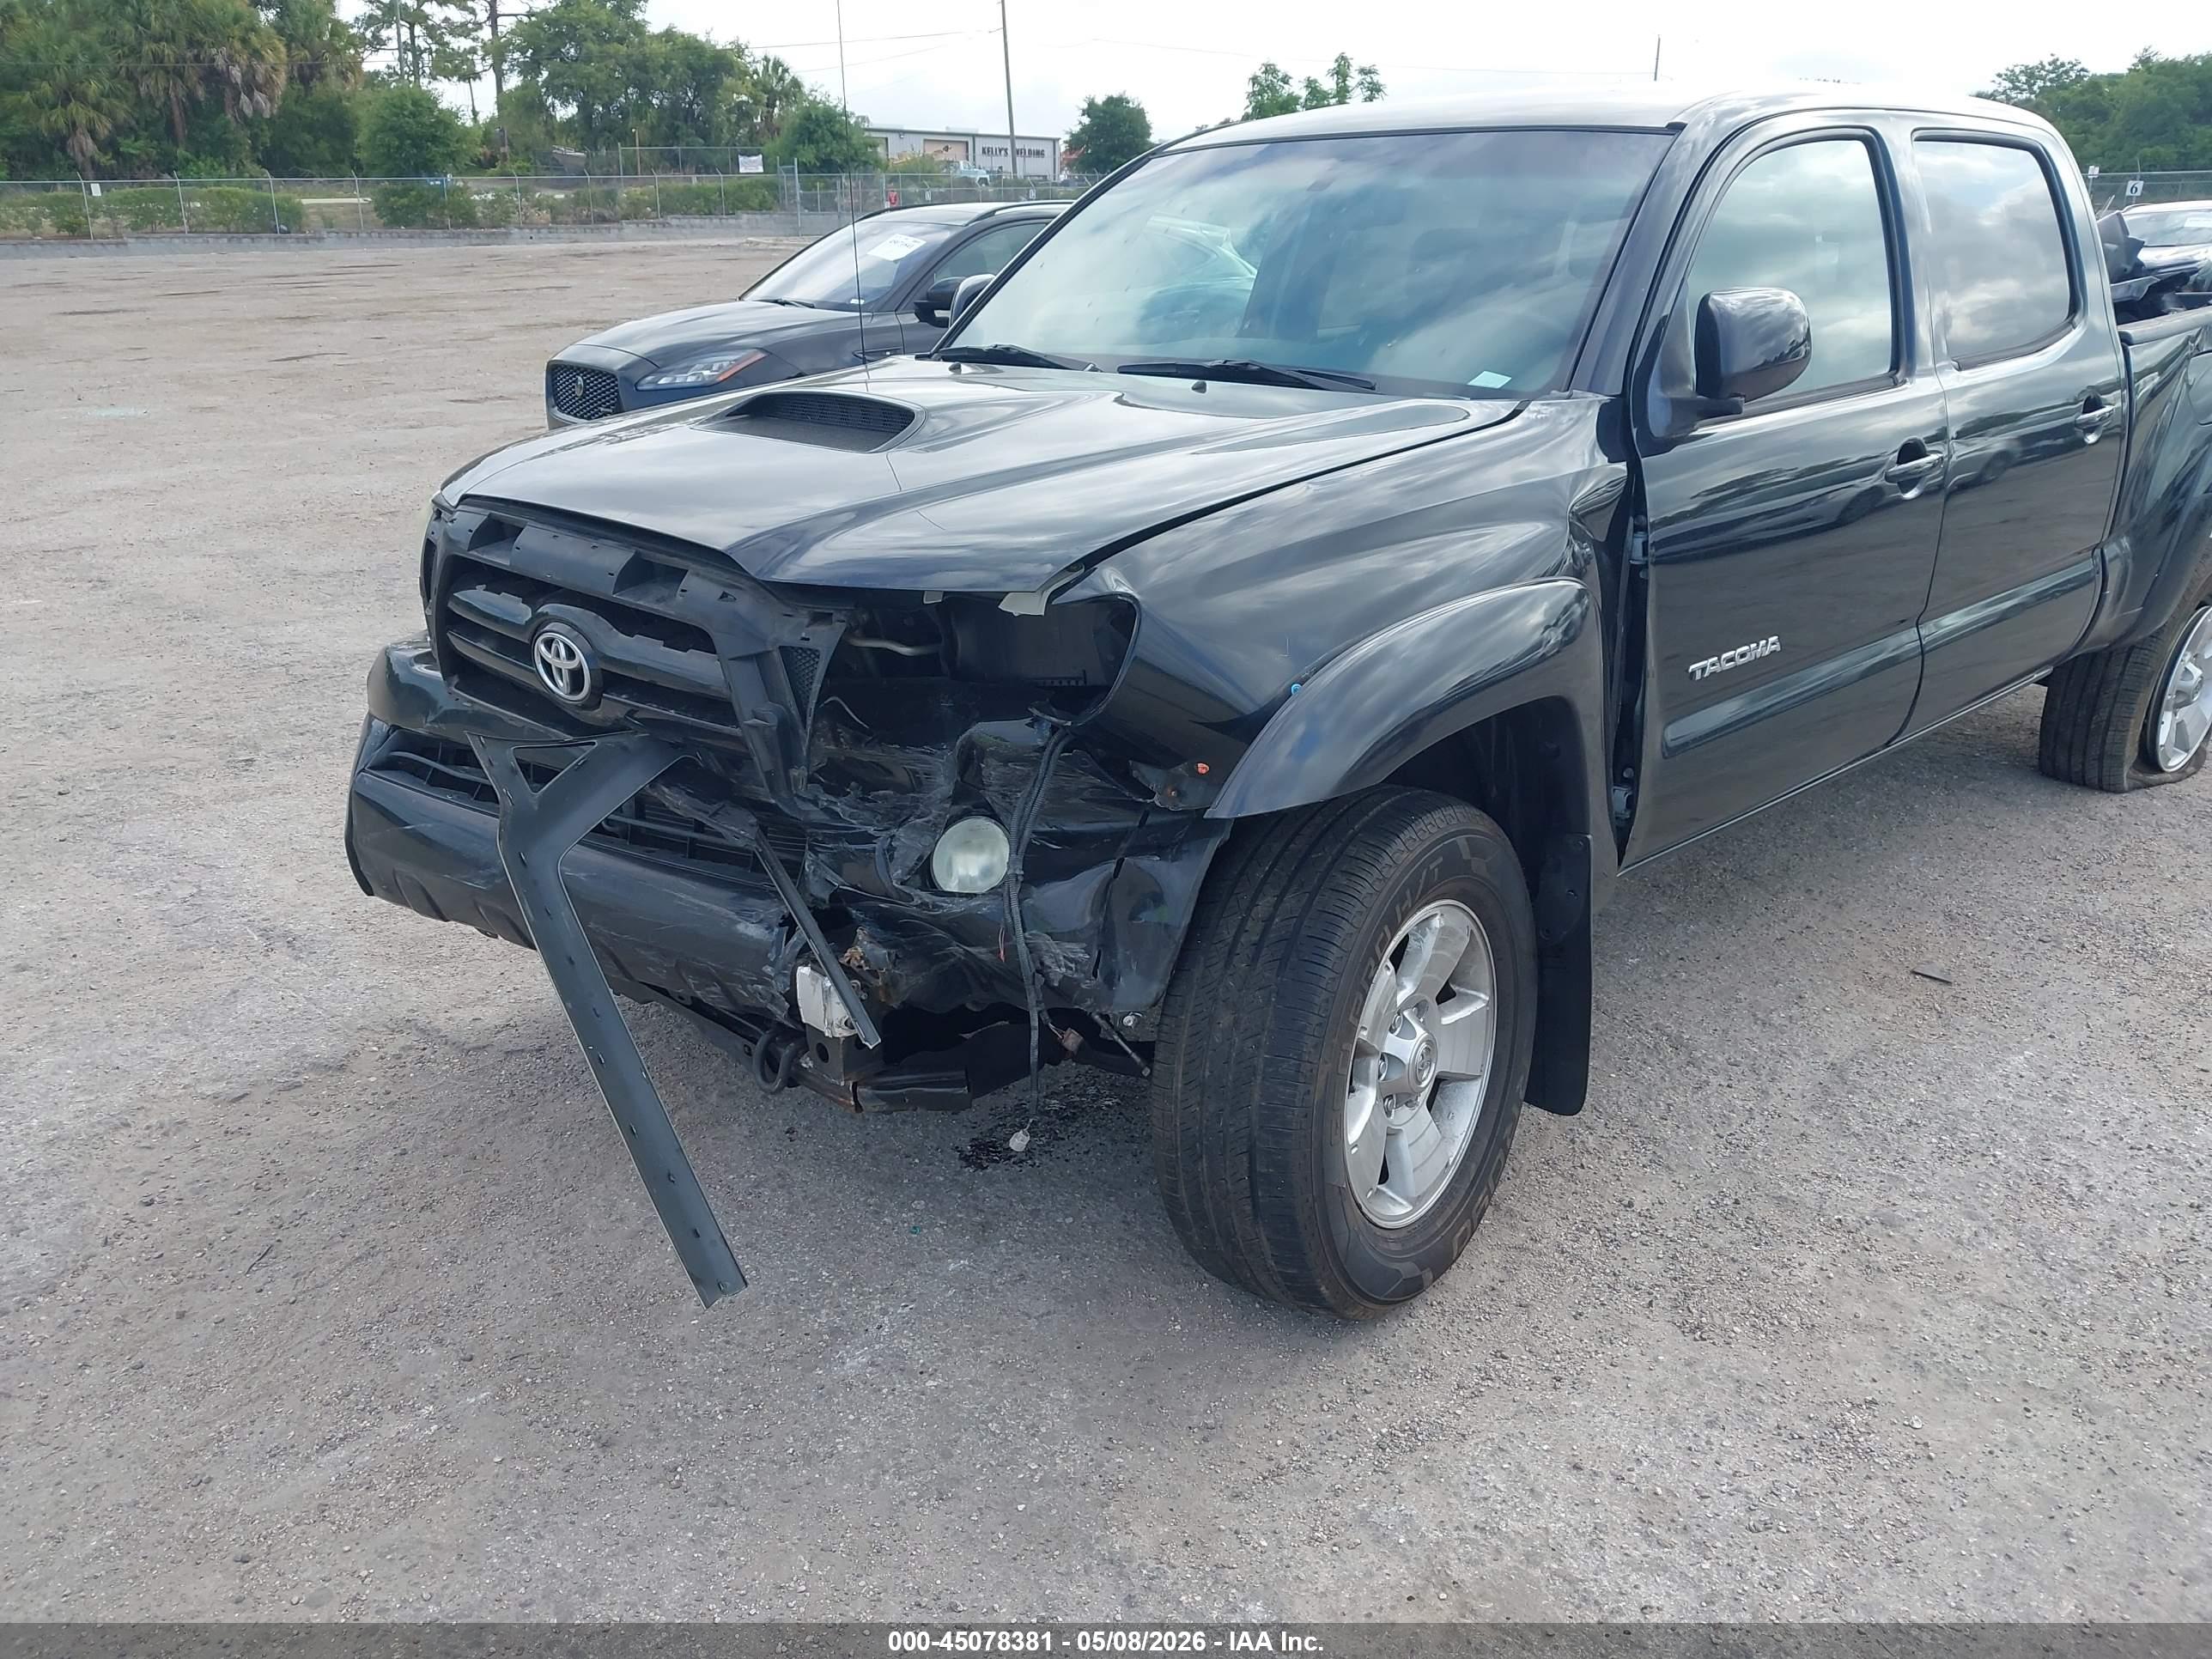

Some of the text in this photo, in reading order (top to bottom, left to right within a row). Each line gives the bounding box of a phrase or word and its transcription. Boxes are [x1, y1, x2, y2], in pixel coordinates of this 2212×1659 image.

[981, 146, 1008, 157] KELLY'S
[2130, 183, 2139, 195] 6
[1688, 635, 1782, 681] TACOMA
[1348, 923, 1392, 1027] PRO
[1395, 856, 1443, 924] H/T
